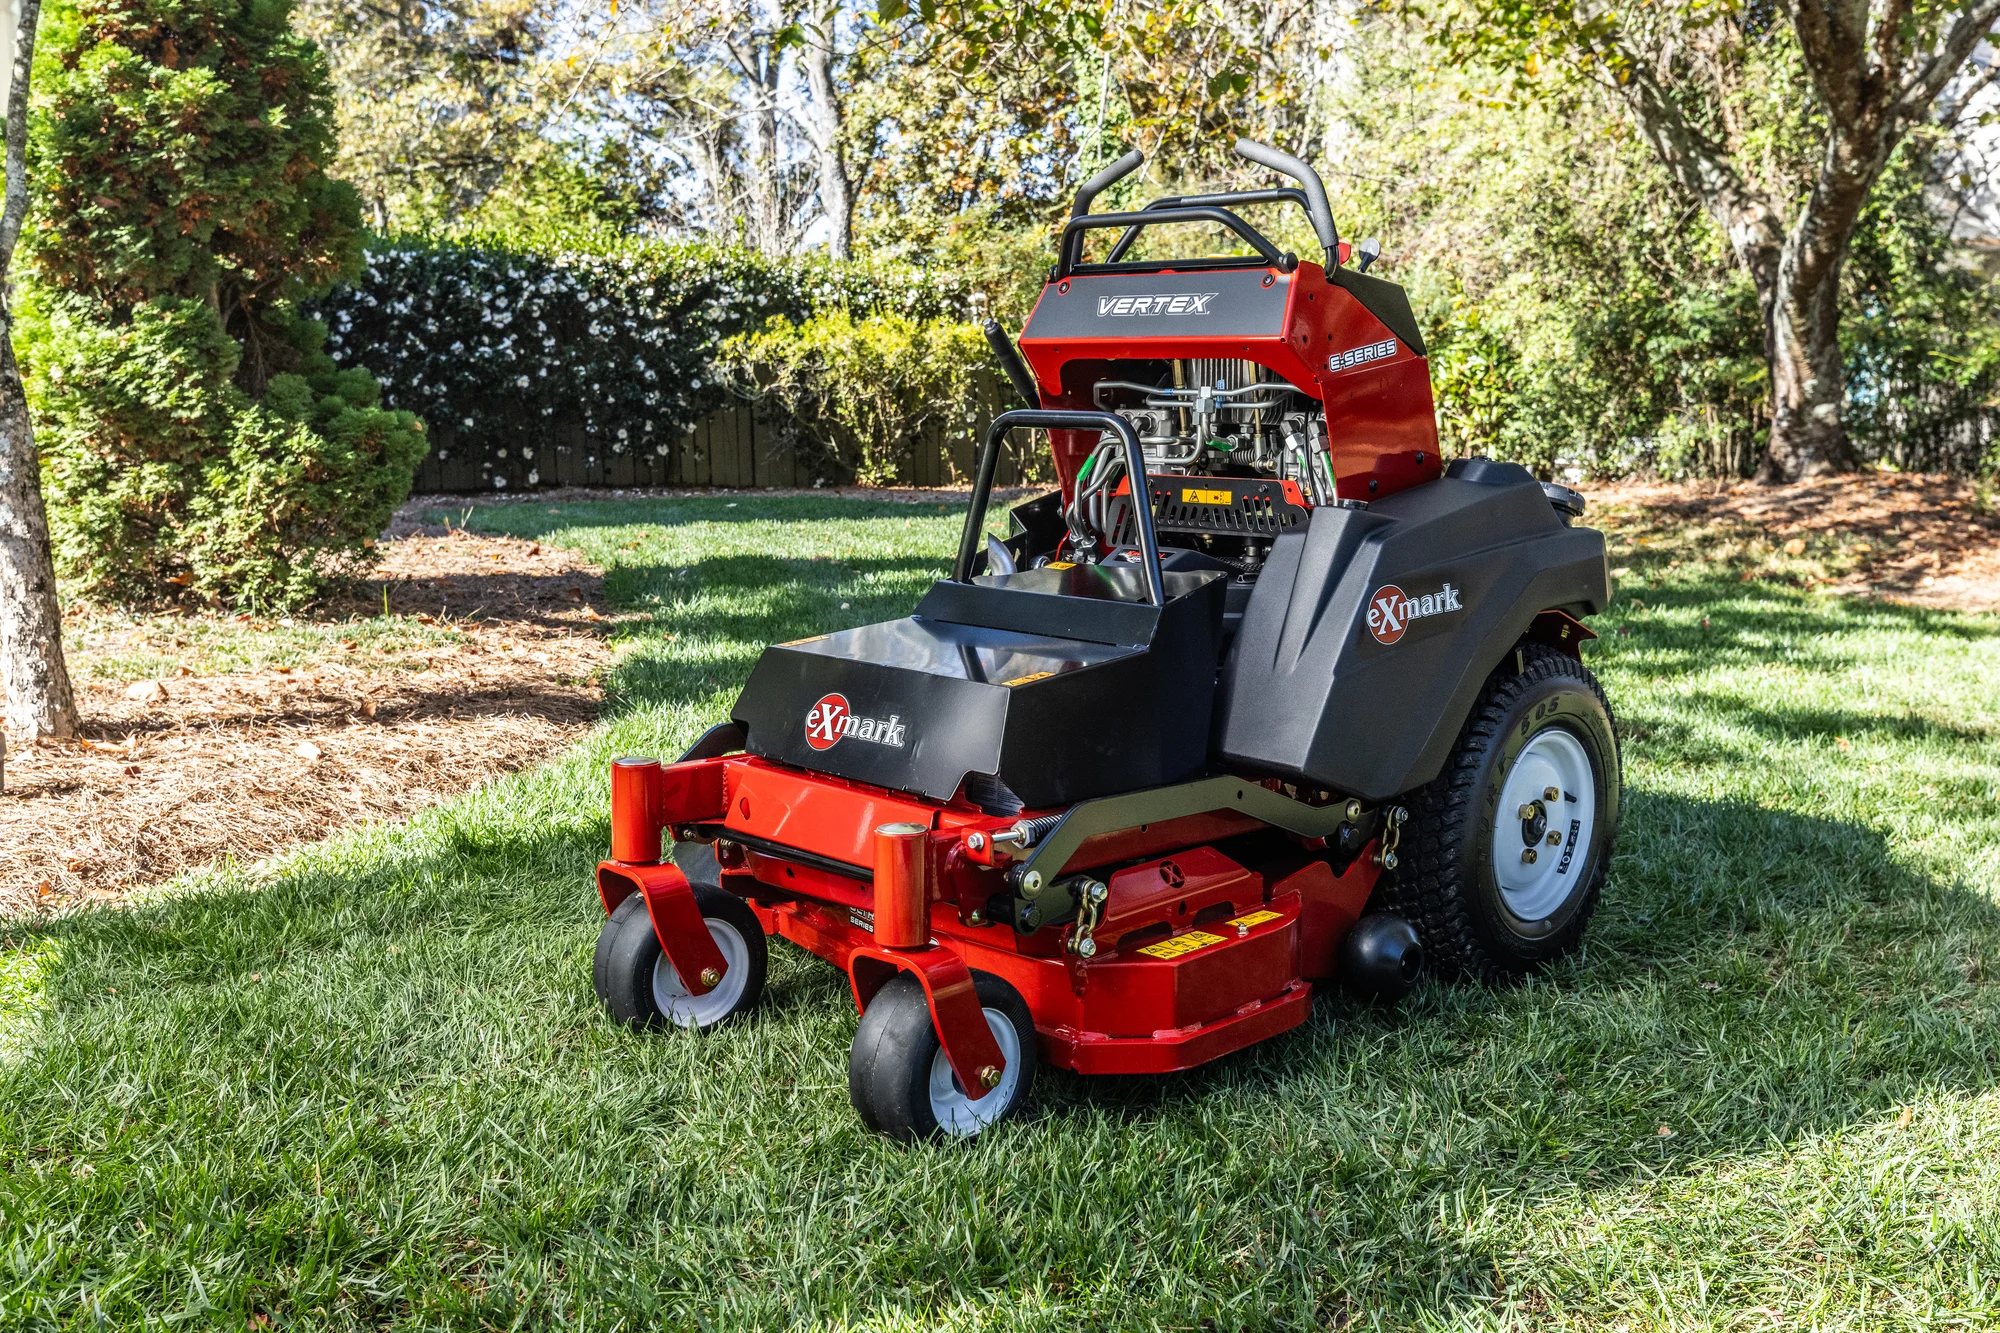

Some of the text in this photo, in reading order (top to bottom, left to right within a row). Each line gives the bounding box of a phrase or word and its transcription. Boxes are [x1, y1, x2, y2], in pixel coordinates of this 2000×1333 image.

[1098, 293, 1217, 316] VERTEX
[1329, 339, 1396, 371] E-SERIES
[850, 915, 874, 933] SERIES
